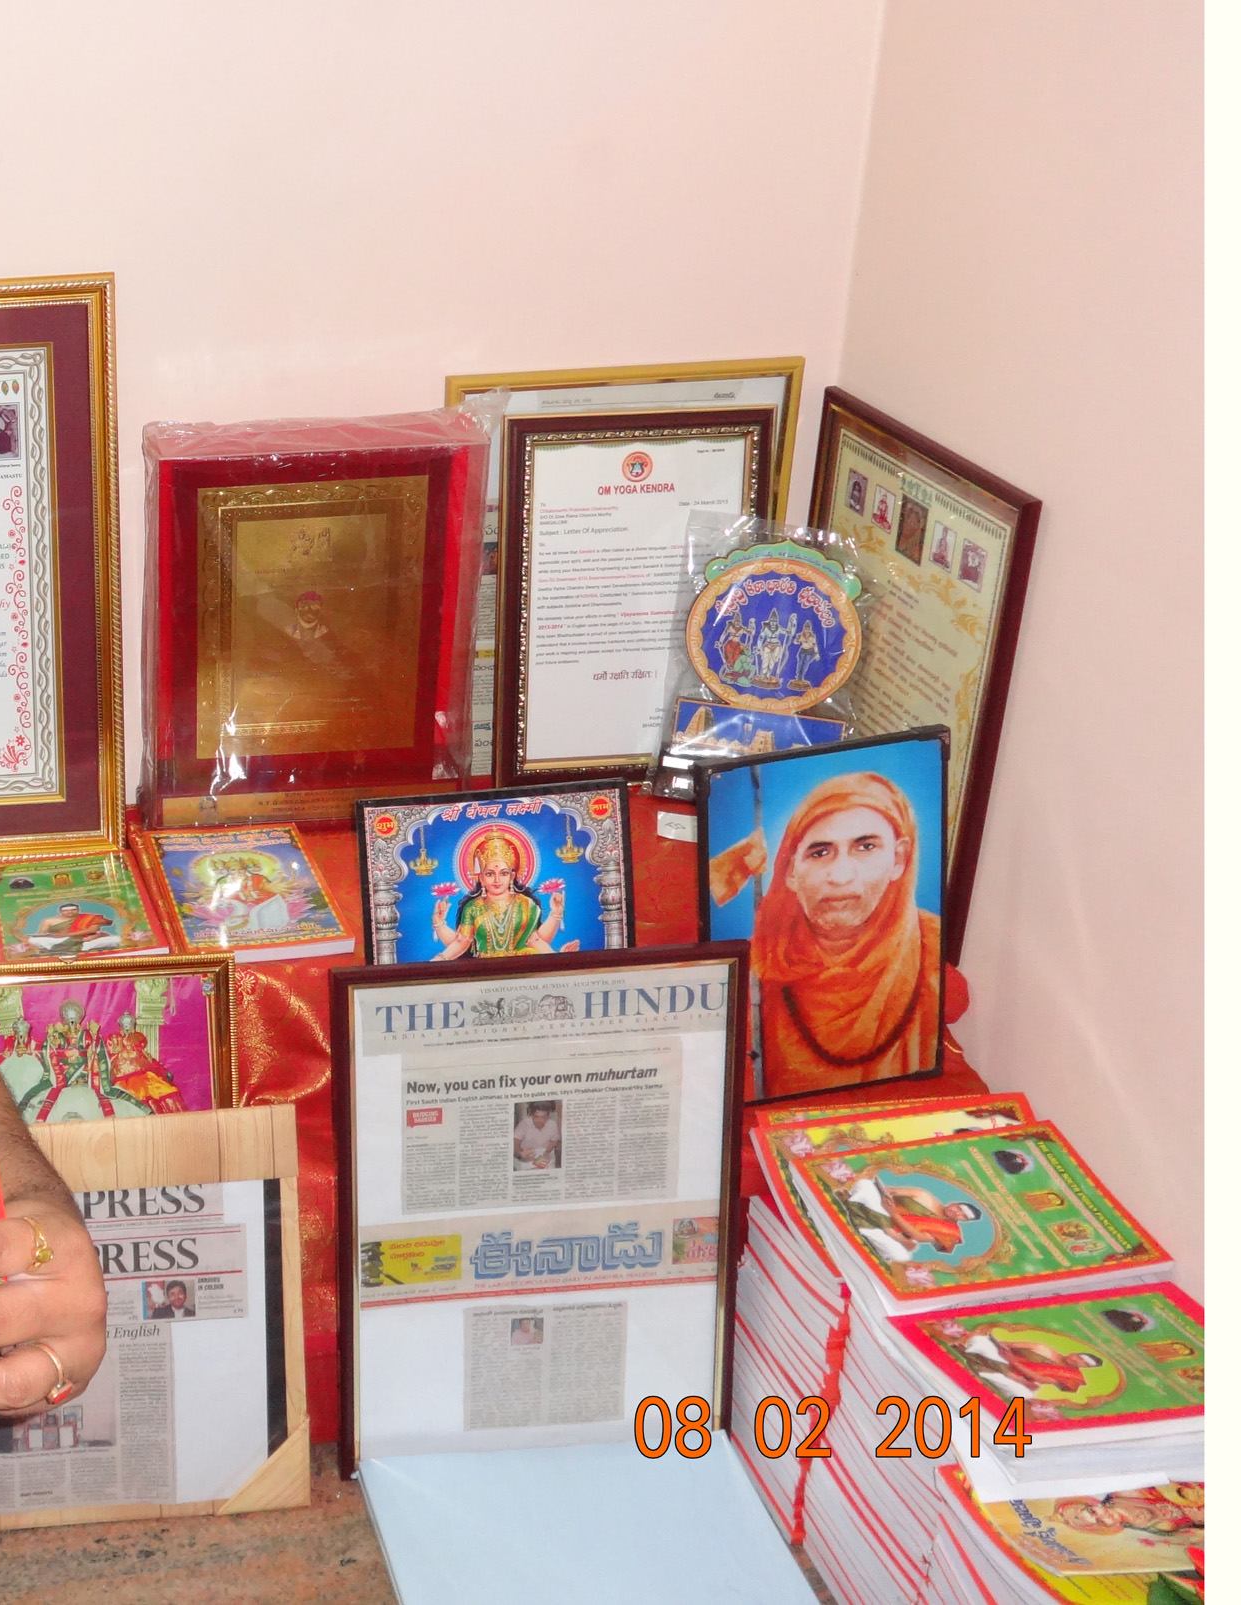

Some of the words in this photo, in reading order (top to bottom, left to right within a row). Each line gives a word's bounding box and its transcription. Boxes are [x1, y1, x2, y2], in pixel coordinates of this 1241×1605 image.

[597, 485, 611, 495] OM
[613, 484, 638, 495] YOGA
[640, 483, 675, 494] KENDRA
[591, 526, 629, 535] Appreciation
[440, 804, 462, 822] श्री
[465, 801, 500, 820] वैभव
[591, 802, 609, 812] लाभ
[376, 820, 395, 832] शुभ
[375, 1000, 465, 1033] THE
[582, 981, 727, 1019] HINDU
[383, 1031, 442, 1041] INDIA'S
[453, 1026, 527, 1037] NATIONAL
[539, 1018, 624, 1031] NEWSPAPER
[635, 1014, 678, 1024] SINCE
[406, 1081, 441, 1094] Now,
[444, 1080, 469, 1095] you
[472, 1079, 496, 1090] can
[499, 1074, 517, 1088] fix
[518, 1074, 552, 1089] your
[554, 1073, 582, 1083] own
[585, 1066, 658, 1083] muhurtam
[83, 1184, 205, 1219] PRESS
[95, 1237, 199, 1275] RESS
[469, 1220, 663, 1281] ఈనాడు
[113, 1325, 160, 1341] English
